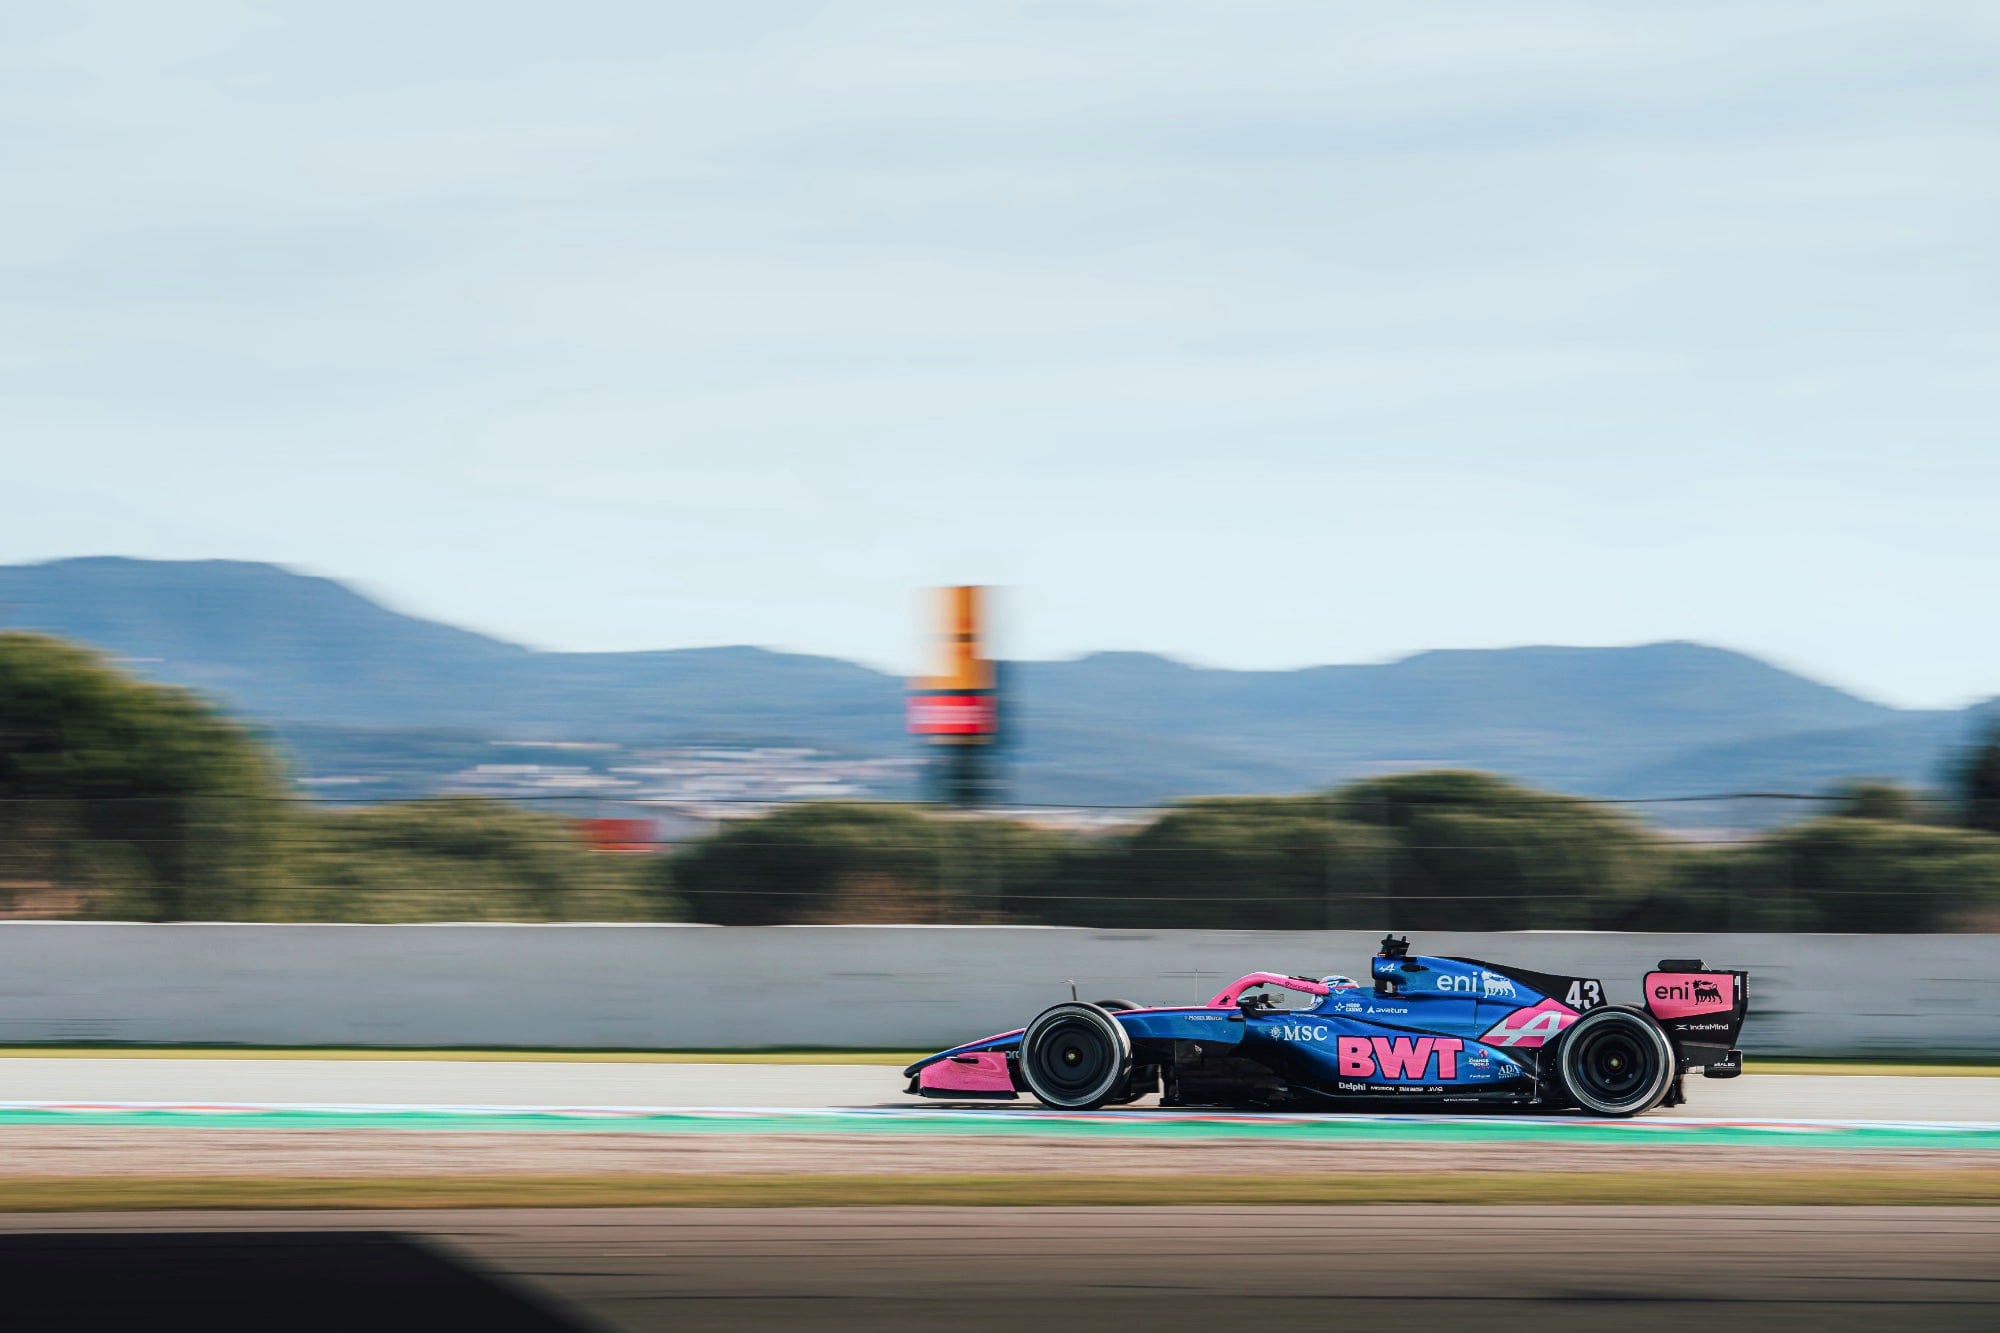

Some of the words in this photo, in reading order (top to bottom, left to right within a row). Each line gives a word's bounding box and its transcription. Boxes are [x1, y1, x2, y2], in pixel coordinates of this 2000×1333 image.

[1437, 971, 1478, 993] eni
[1655, 981, 1689, 1000] eni
[1565, 981, 1600, 1010] 43
[1283, 1025, 1328, 1042] MSC
[1337, 1036, 1464, 1079] BWT
[1338, 1081, 1366, 1091] Delphi
